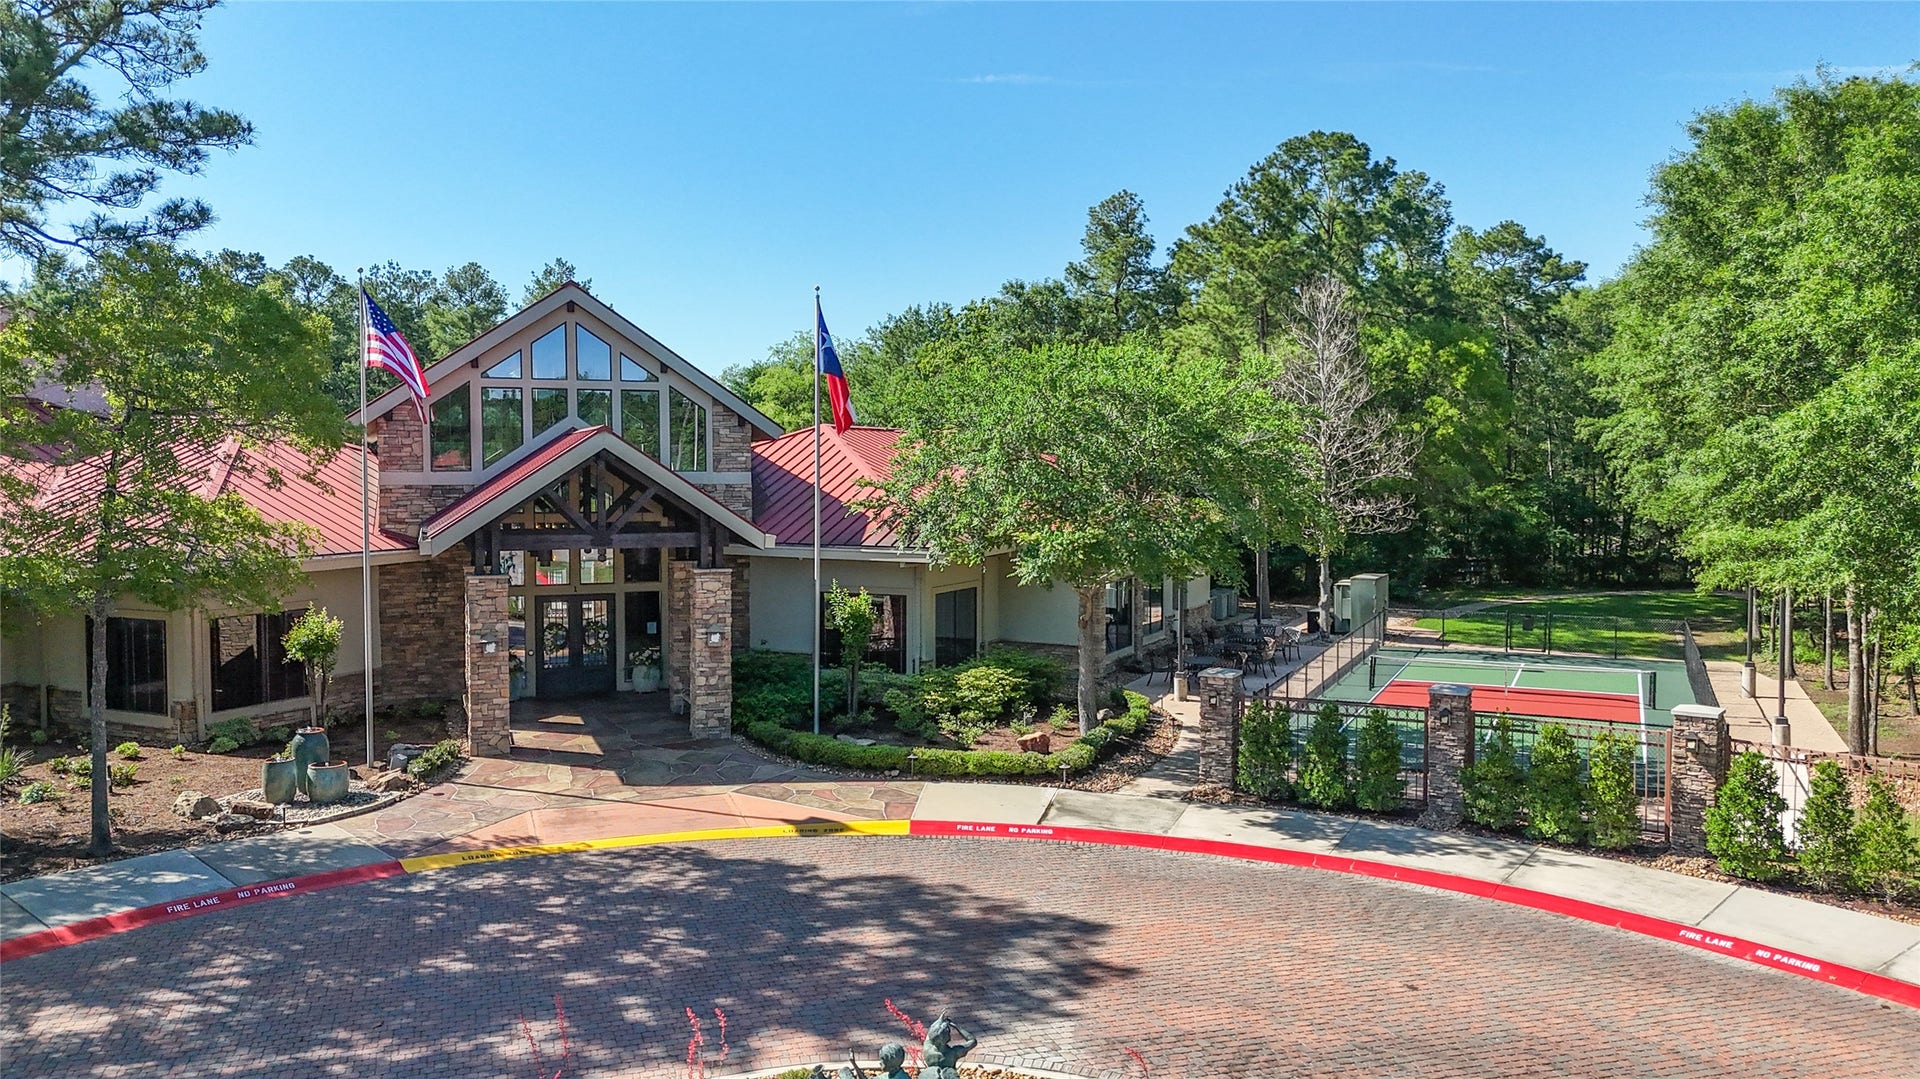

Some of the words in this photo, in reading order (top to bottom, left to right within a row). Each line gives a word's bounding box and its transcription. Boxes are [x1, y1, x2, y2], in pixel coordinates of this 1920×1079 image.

[166, 902, 191, 914] FIRE
[192, 896, 221, 909] LANE
[236, 890, 252, 899] NO
[253, 882, 296, 896] PARKING
[1679, 930, 1703, 941] FIRE
[1705, 936, 1734, 949] LANE
[1755, 949, 1771, 959] NO
[1773, 954, 1820, 972] PARKING
